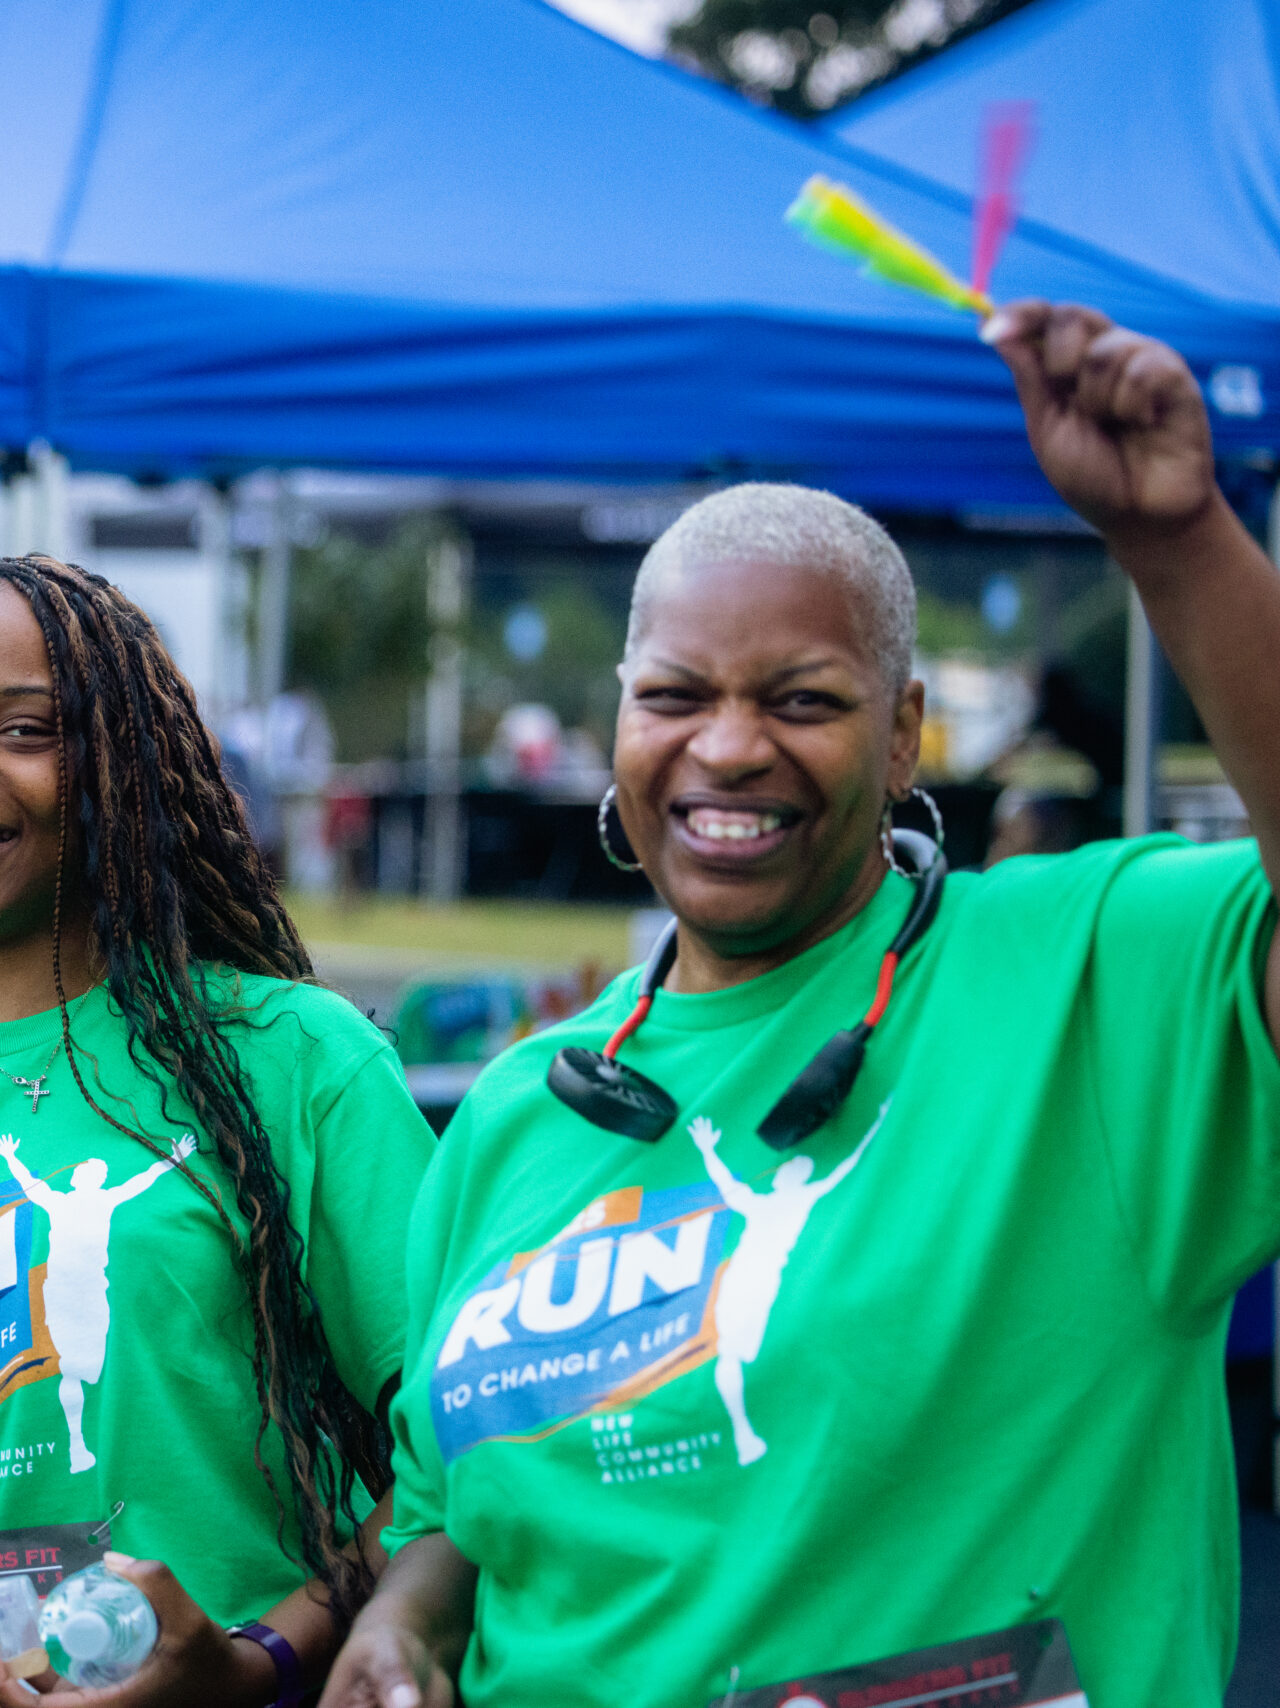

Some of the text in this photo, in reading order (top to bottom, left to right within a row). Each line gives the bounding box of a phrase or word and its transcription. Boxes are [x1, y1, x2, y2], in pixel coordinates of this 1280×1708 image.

[438, 1212, 714, 1370] RUN
[441, 1312, 690, 1414] TO CHANGE A LIFE
[25, 1548, 61, 1565] FIT
